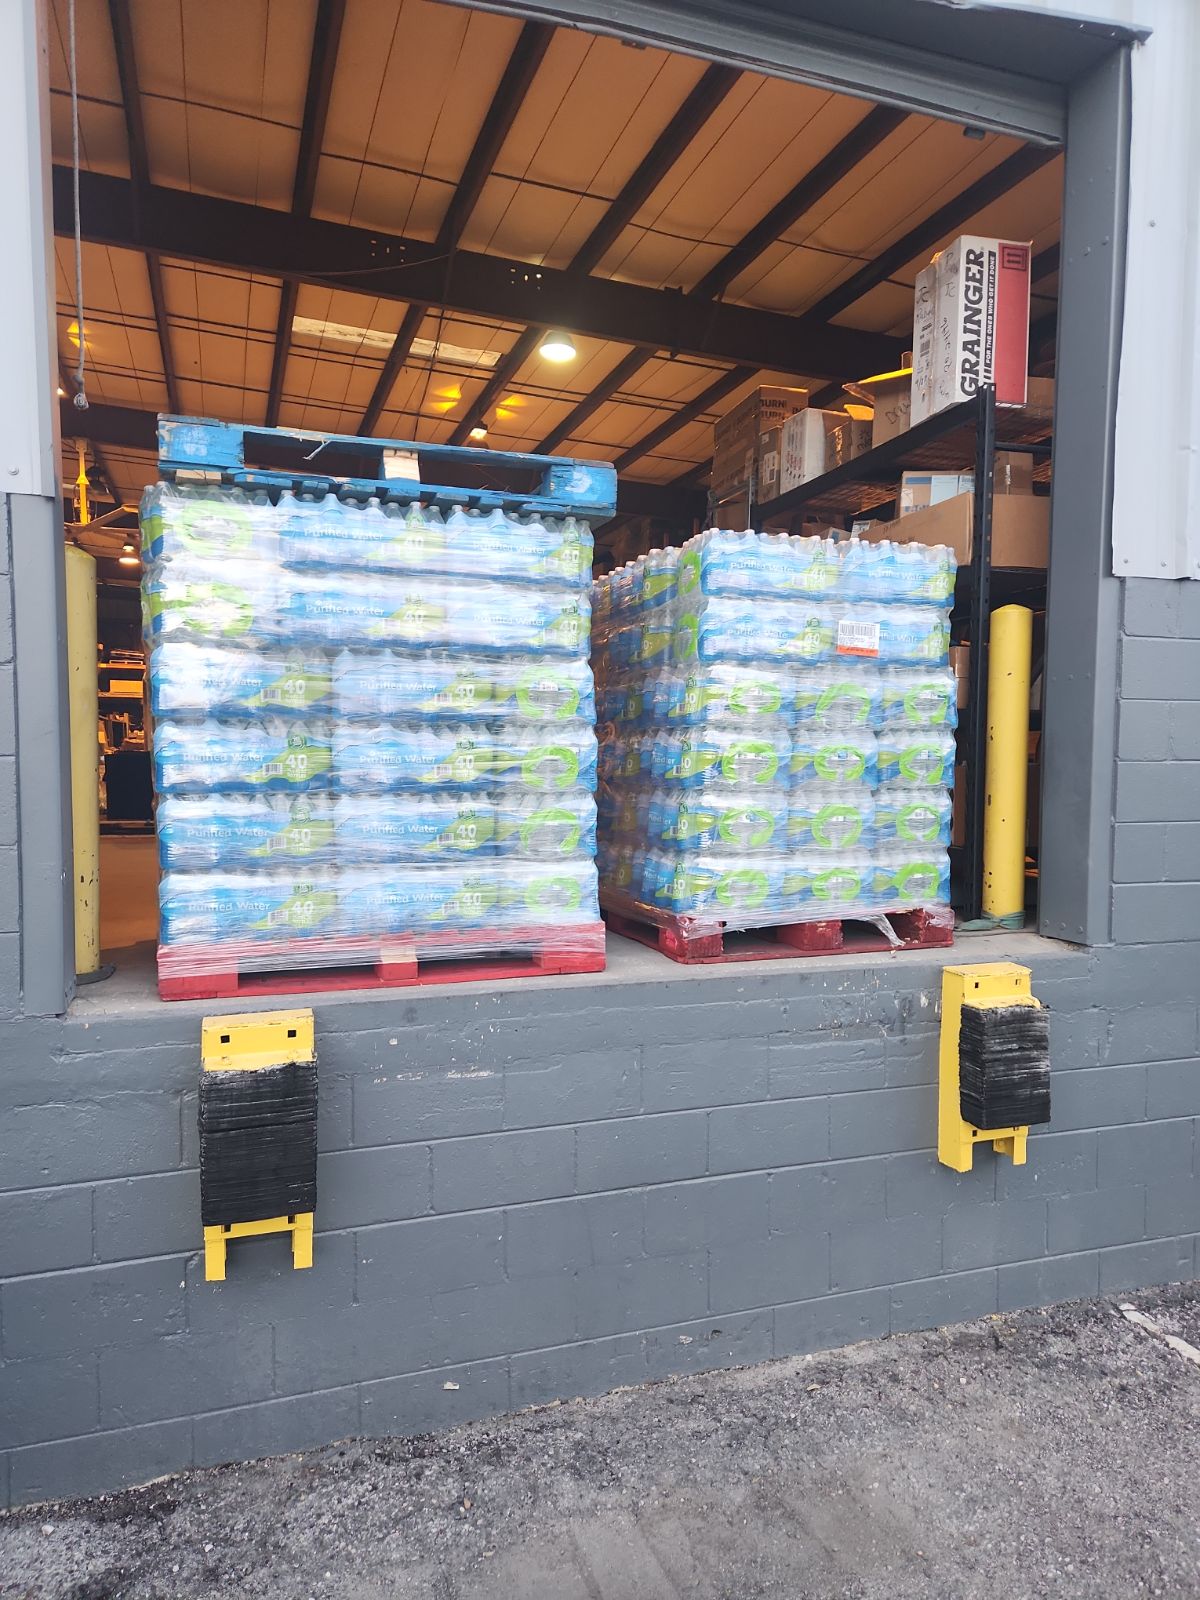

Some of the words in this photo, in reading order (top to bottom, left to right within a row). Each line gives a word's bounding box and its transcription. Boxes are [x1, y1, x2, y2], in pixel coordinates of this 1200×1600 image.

[960, 248, 984, 396] GRAINGER
[283, 679, 306, 694] 40
[232, 752, 264, 762] Water
[285, 754, 308, 768] 40
[406, 755, 437, 764] Water
[455, 755, 475, 769] 40
[187, 828, 232, 838] Purified
[236, 828, 269, 837] Water
[289, 828, 312, 843] 40
[363, 824, 405, 835] Purified
[408, 824, 439, 834] Water
[456, 824, 477, 838] 40
[413, 893, 444, 903] Water
[462, 893, 482, 905] 40
[188, 902, 232, 912] Purified
[236, 901, 271, 911] Water
[291, 901, 314, 915] 40
